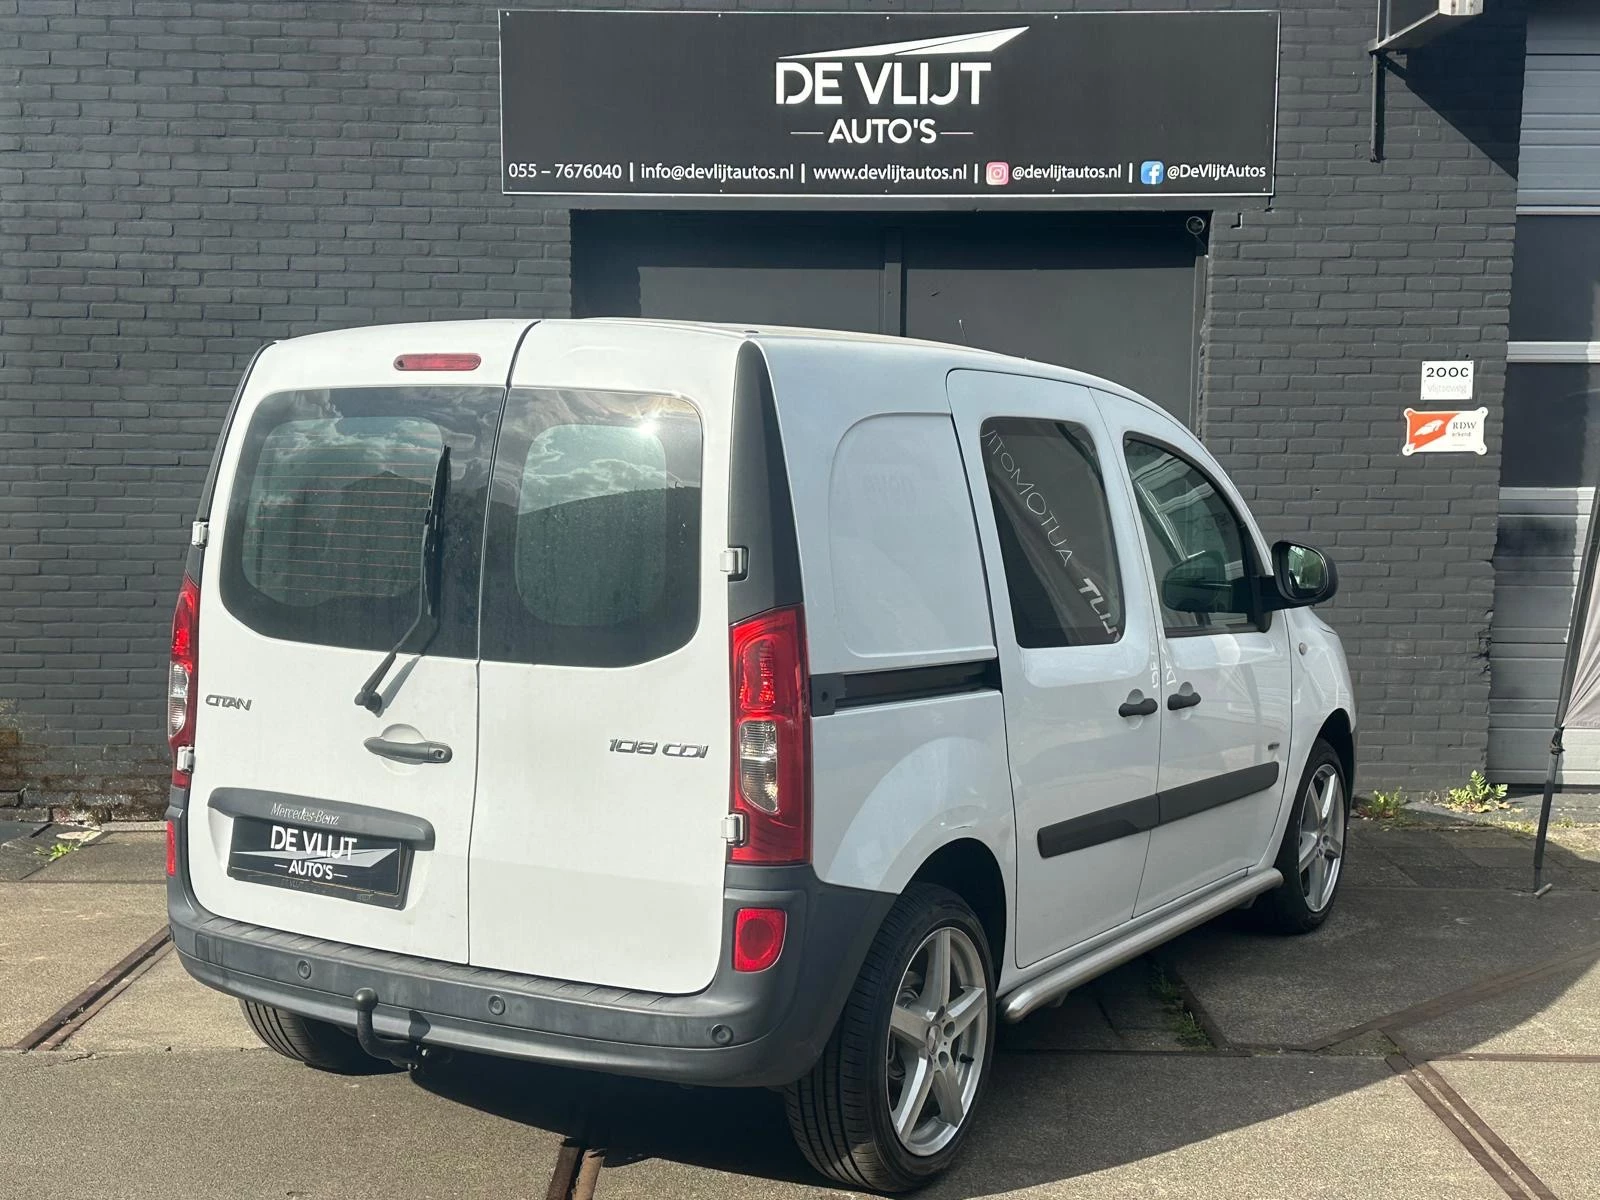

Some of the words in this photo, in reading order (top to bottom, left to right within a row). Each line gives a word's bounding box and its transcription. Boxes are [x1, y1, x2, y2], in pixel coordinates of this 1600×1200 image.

[775, 61, 843, 105] DE
[854, 62, 992, 106] VLIJT
[827, 117, 938, 145] AUTO'S
[508, 162, 538, 179] 055
[554, 162, 623, 180] 7676040
[640, 162, 795, 183] info@devlijtautos.nl
[812, 163, 968, 183] www.devlijtautos.nl
[1011, 163, 1122, 183] @devlijtautos.nl
[1166, 163, 1266, 183] @DeVlijtAutos
[1426, 367, 1469, 378] 200C
[1452, 420, 1477, 430] RDW
[205, 693, 252, 712] CITAN
[608, 738, 659, 755] 108
[661, 742, 709, 759] CDI
[270, 802, 341, 826] Mercedes-Benz
[270, 825, 299, 851] DE
[302, 830, 358, 861] VLIJT
[288, 860, 334, 881] AUTO'S
